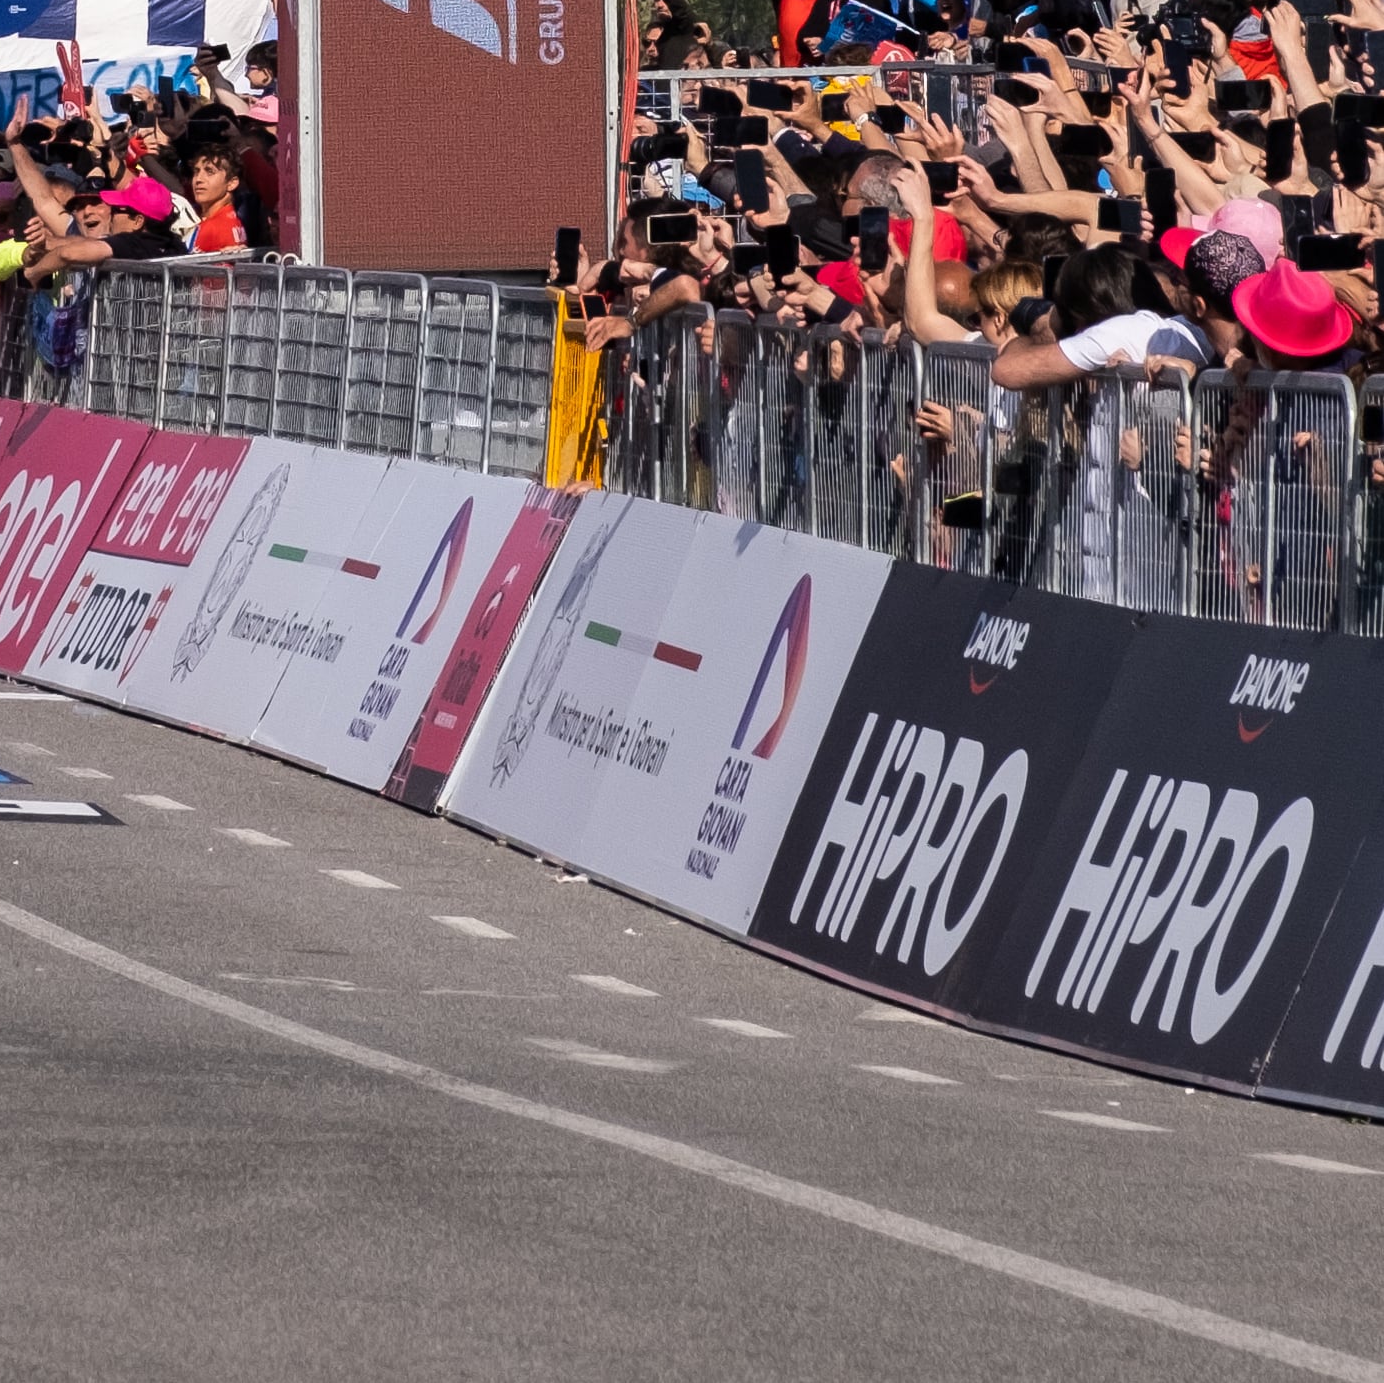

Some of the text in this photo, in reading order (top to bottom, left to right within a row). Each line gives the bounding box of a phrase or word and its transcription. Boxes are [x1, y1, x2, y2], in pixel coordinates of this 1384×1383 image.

[105, 441, 248, 556] enel enel
[58, 582, 153, 673] TUDOR
[697, 805, 748, 855] GIOVANI
[789, 712, 1029, 977] HiPRO
[1024, 768, 1315, 1046] HiPRO
